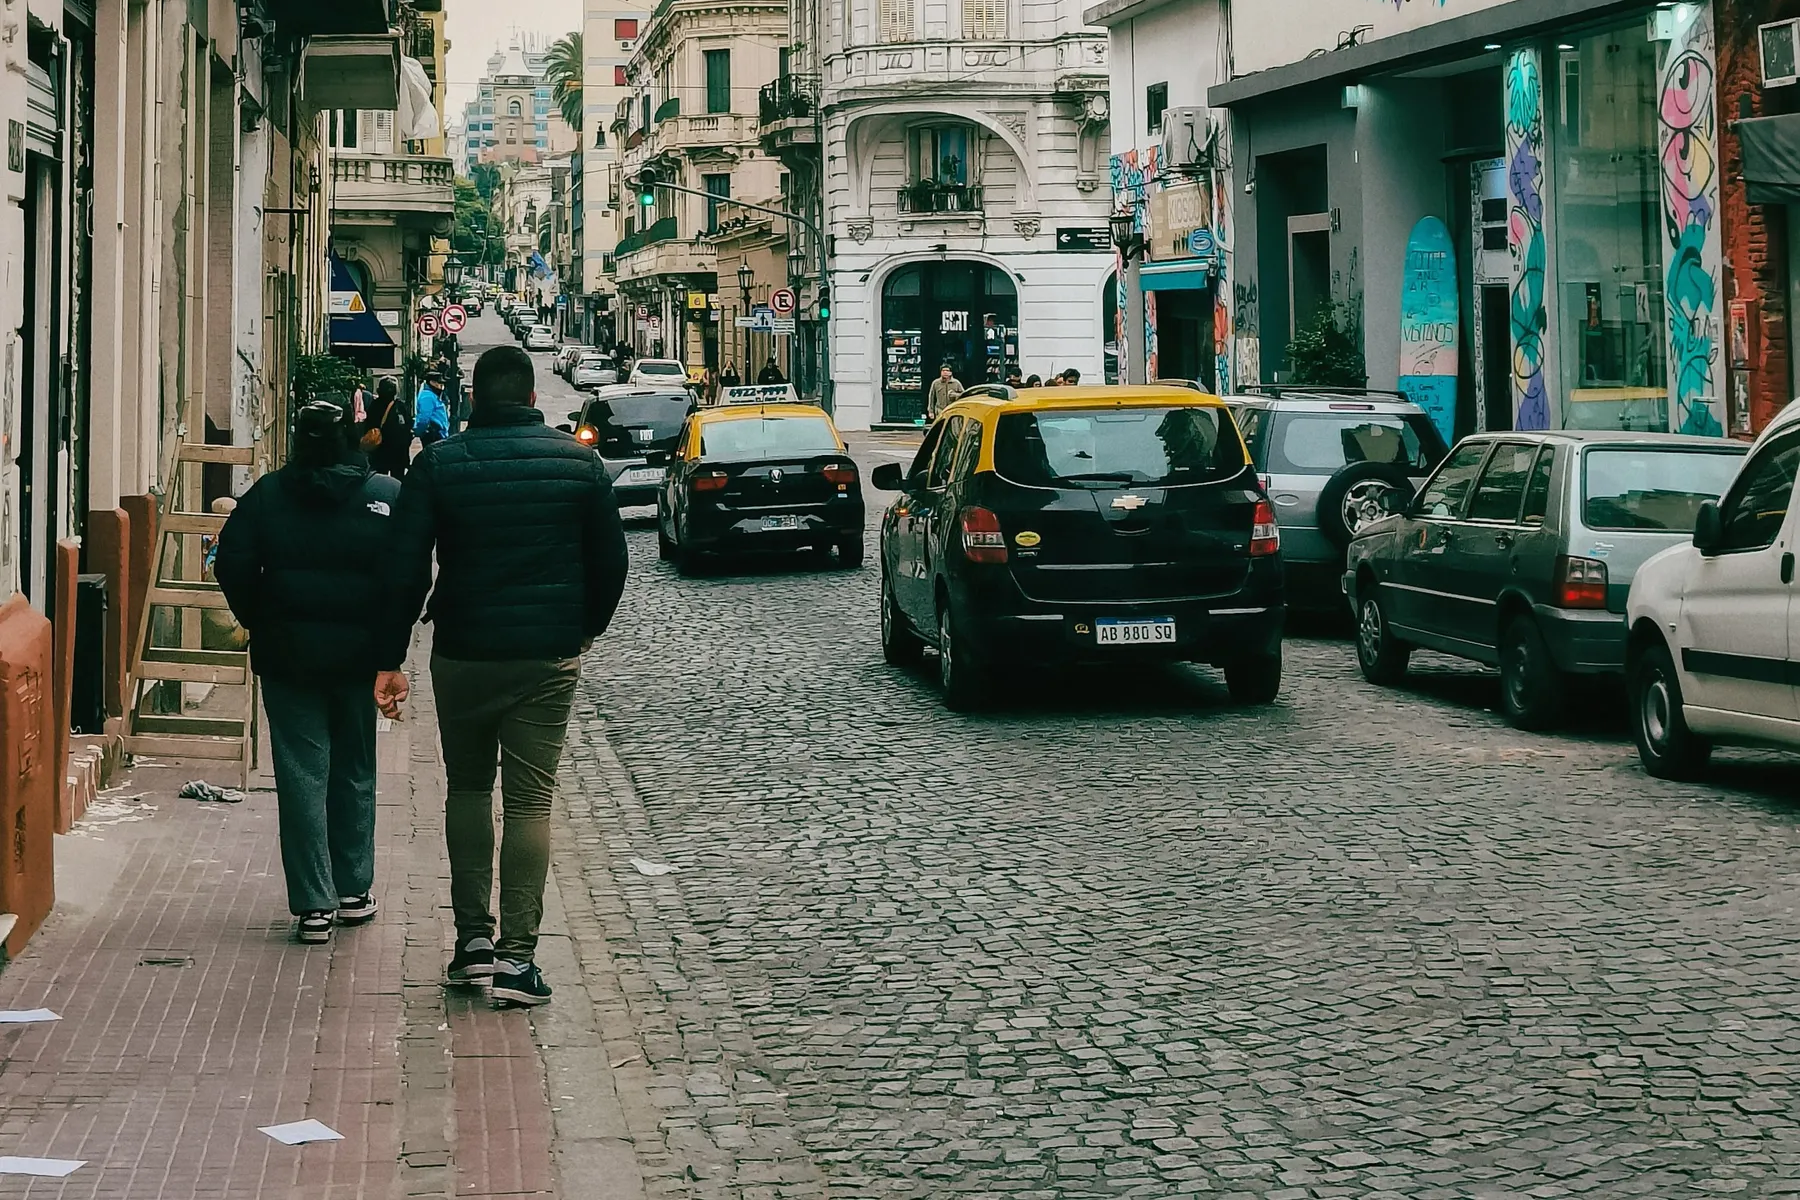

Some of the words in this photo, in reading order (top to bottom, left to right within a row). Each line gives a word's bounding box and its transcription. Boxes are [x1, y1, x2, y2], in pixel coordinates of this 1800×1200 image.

[1169, 196, 1200, 224] KIOSCO
[1101, 626, 1118, 641] AB
[1123, 625, 1149, 641] 880
